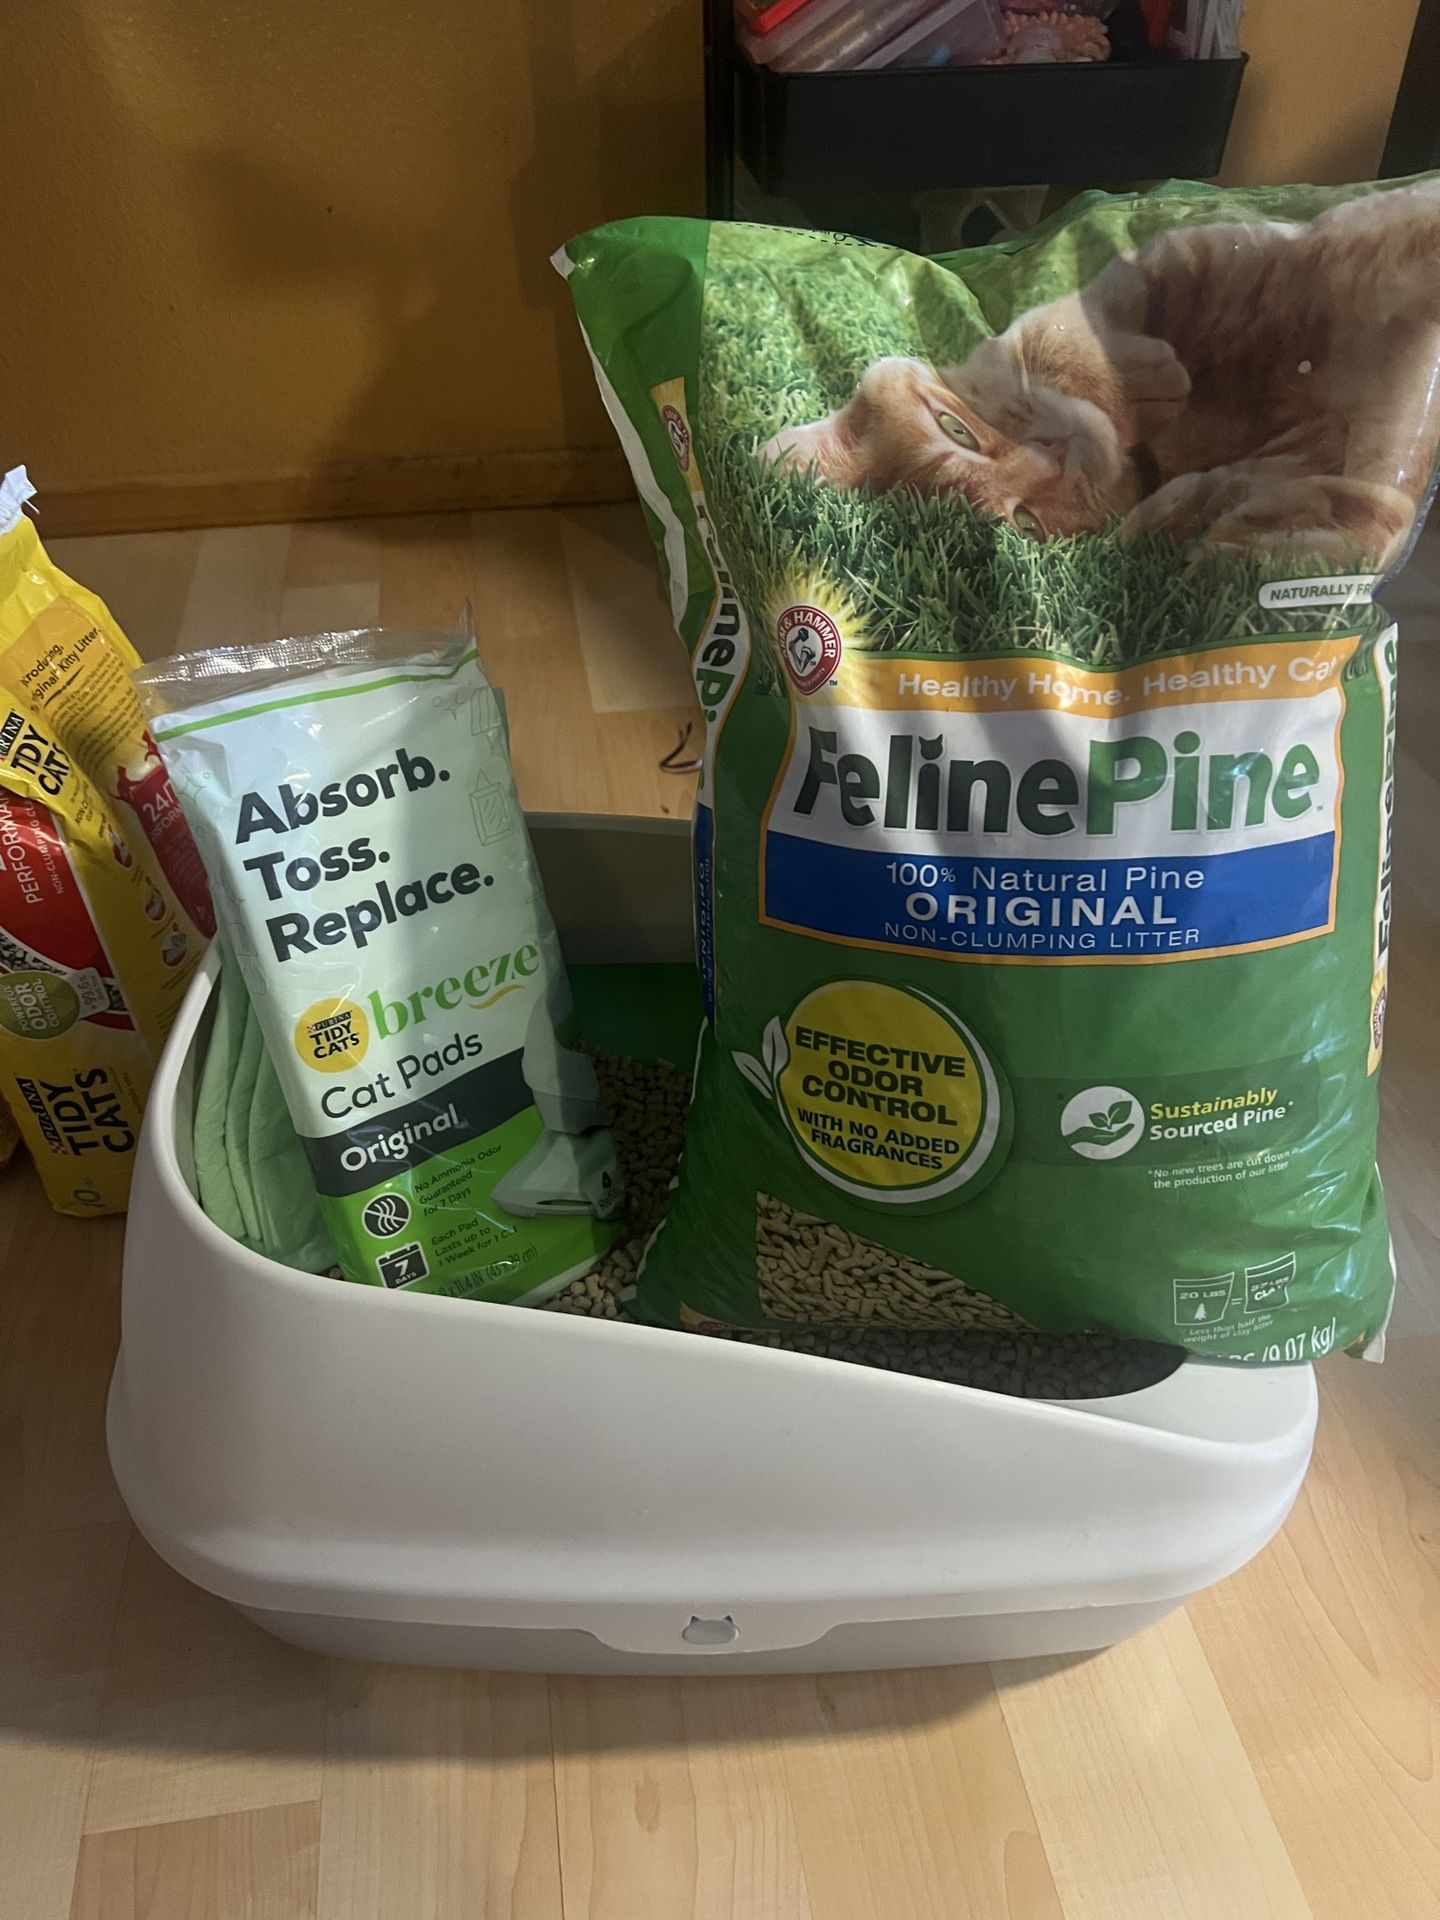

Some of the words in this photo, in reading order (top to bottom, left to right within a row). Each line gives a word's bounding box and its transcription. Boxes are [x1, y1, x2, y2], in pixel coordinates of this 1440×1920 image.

[1270, 583, 1353, 601] NATURALLY
[793, 610, 837, 659] HAMMER
[57, 651, 80, 672] Kitty
[898, 673, 1018, 700] Healthy
[1143, 661, 1278, 697] Healthy
[235, 747, 450, 845] Absorb.
[242, 837, 390, 901] Toss.
[885, 862, 956, 888] 100%
[972, 865, 1107, 892] Natural
[1126, 865, 1205, 890] Pine
[265, 863, 494, 963] Replace.
[905, 892, 1178, 928] ORIGINAL
[884, 922, 1097, 950] NON-CLUMPING
[1110, 928, 1200, 949] LITTER
[3, 983, 33, 1032] POWERFUL
[14, 982, 48, 1030] ODOR
[32, 977, 61, 1027] CONTROL
[367, 943, 540, 1040] breeze
[309, 1020, 351, 1046] TIDY
[313, 1032, 360, 1059] CATS
[795, 1026, 966, 1078] EFFECTIVE
[320, 1073, 396, 1119] Cat
[396, 1032, 483, 1090] Pads
[828, 1060, 923, 1097] ODOR
[38, 1079, 100, 1157] TIDY
[75, 1068, 136, 1153] CATS
[802, 1074, 958, 1126] CONTROL
[1150, 1087, 1279, 1121] Sustainably
[340, 1103, 459, 1172] Original
[797, 1107, 843, 1133] WITH
[849, 1121, 879, 1140] NO
[884, 1129, 960, 1155] ADDED
[1150, 1112, 1238, 1141] Sourced
[811, 1128, 943, 1170] FRAGRANCES
[1171, 1166, 1195, 1176] new
[1198, 1163, 1224, 1173] trees
[1226, 1160, 1244, 1170] are
[1246, 1156, 1262, 1167] cut
[1263, 1150, 1291, 1164] down
[414, 1181, 430, 1193] No
[431, 1157, 476, 1185] Ammonia
[477, 1144, 502, 1161] Odor
[419, 1169, 473, 1204] Guaranteed
[1153, 1179, 1171, 1189] the
[1173, 1172, 1233, 1189] production
[1235, 1169, 1247, 1181] of
[1249, 1167, 1266, 1177] our
[423, 1205, 439, 1217] for
[439, 1199, 446, 1208] 7
[448, 1186, 472, 1204] Days
[431, 1229, 457, 1246] Each
[458, 1218, 479, 1232] Pad
[434, 1240, 463, 1257] Lasts
[464, 1234, 478, 1246] up
[480, 1227, 492, 1237] to
[395, 1259, 409, 1276] 7
[445, 1247, 476, 1264] Week
[477, 1239, 492, 1250] for
[395, 1271, 417, 1285] DAYS
[1179, 1291, 1199, 1300] 20
[1203, 1289, 1226, 1298] LBS
[1213, 1324, 1235, 1333] than
[1237, 1319, 1256, 1329] half
